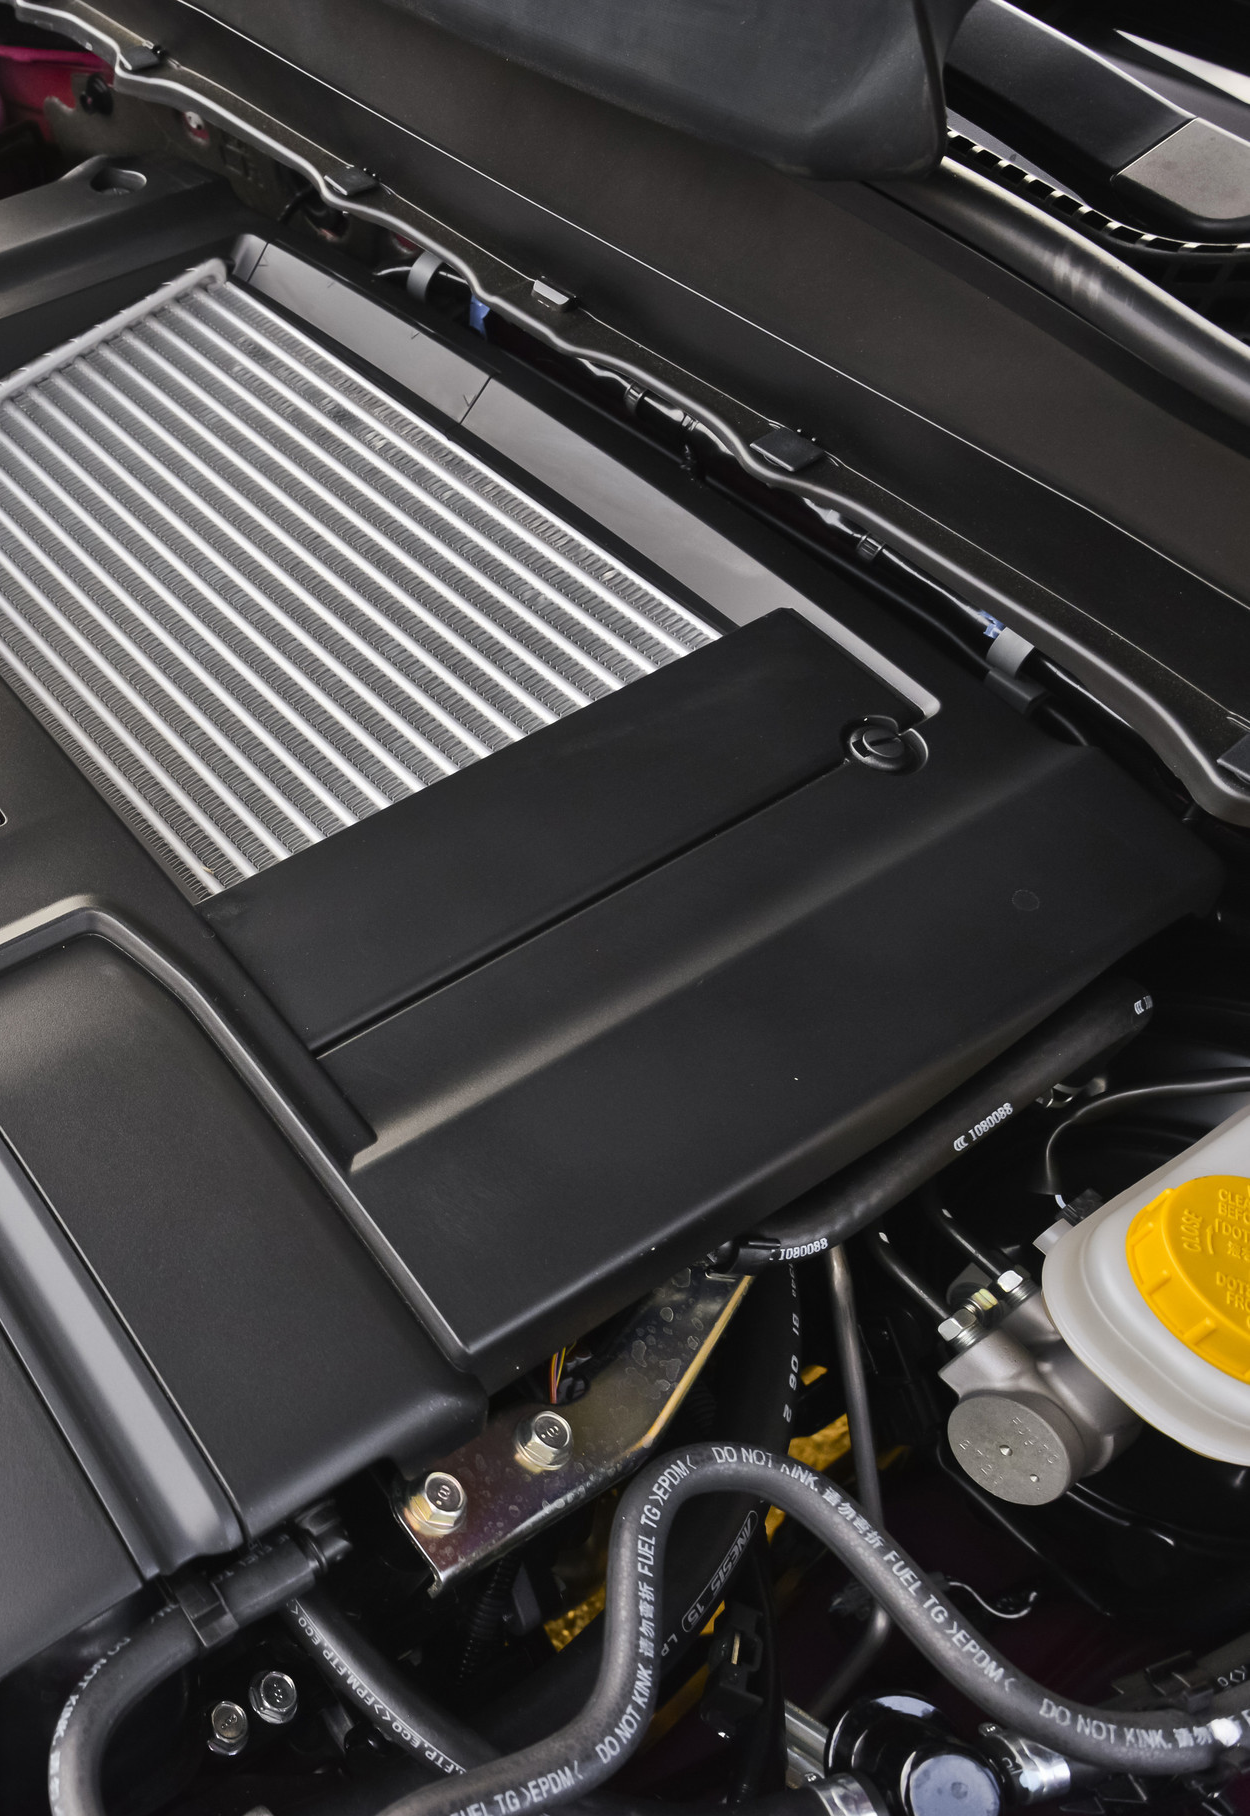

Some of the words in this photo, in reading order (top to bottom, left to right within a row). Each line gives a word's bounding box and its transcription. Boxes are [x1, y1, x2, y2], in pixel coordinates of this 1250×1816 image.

[1180, 1208, 1203, 1252] CLOSE
[711, 1446, 738, 1463] DO
[740, 1447, 773, 1468] NOT
[640, 1504, 661, 1528] TG
[638, 1535, 656, 1577] FUEL
[883, 1550, 922, 1597] FUEL
[922, 1594, 949, 1624] TG
[595, 1735, 620, 1764] DO
[614, 1704, 641, 1744] NOT
[1039, 1698, 1071, 1726] DO
[1076, 1714, 1117, 1744] NOT
[493, 1790, 520, 1814] TG
